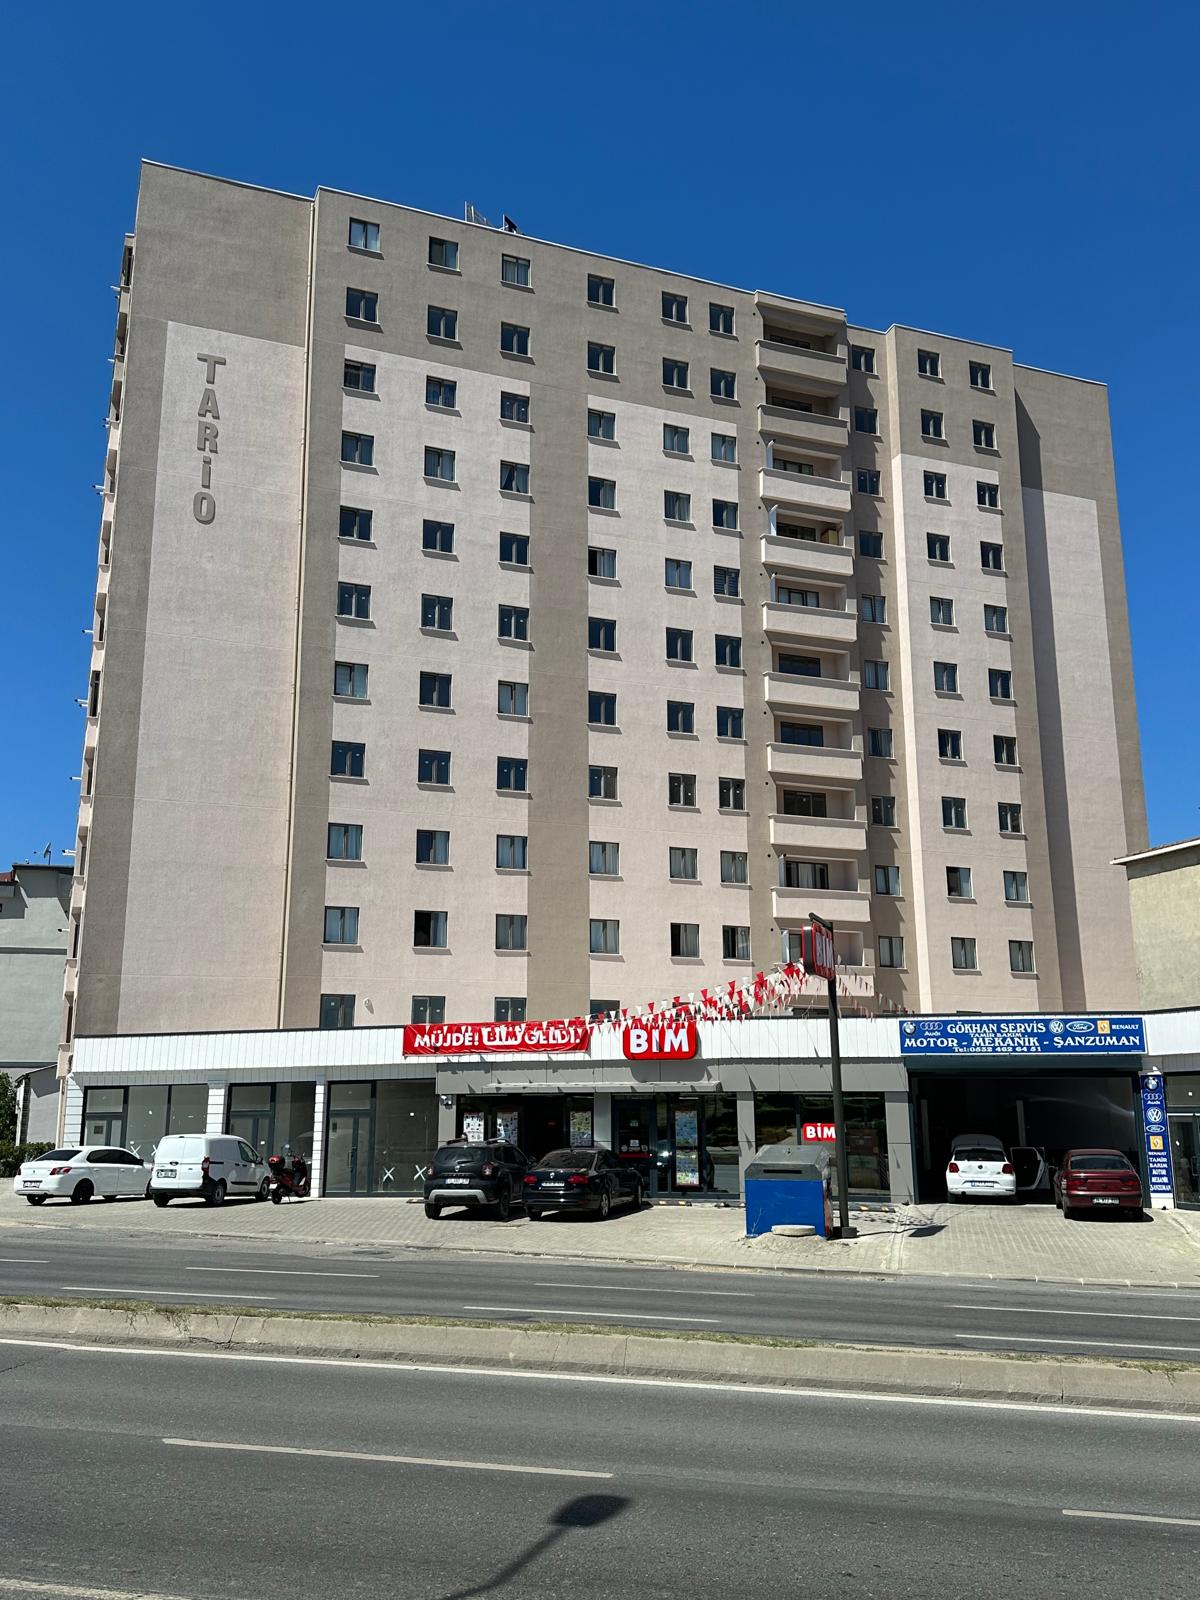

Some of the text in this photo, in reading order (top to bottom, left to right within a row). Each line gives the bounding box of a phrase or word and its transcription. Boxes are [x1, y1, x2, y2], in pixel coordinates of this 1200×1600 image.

[947, 1021, 1046, 1034] GÖKHAN SERVİS
[414, 1030, 479, 1047] MÜJDE!
[904, 1038, 958, 1047] MOTOR
[972, 1035, 1040, 1047] MEKANİK
[1053, 1036, 1140, 1048] ŞANZUMAN
[806, 1123, 836, 1139] BİM
